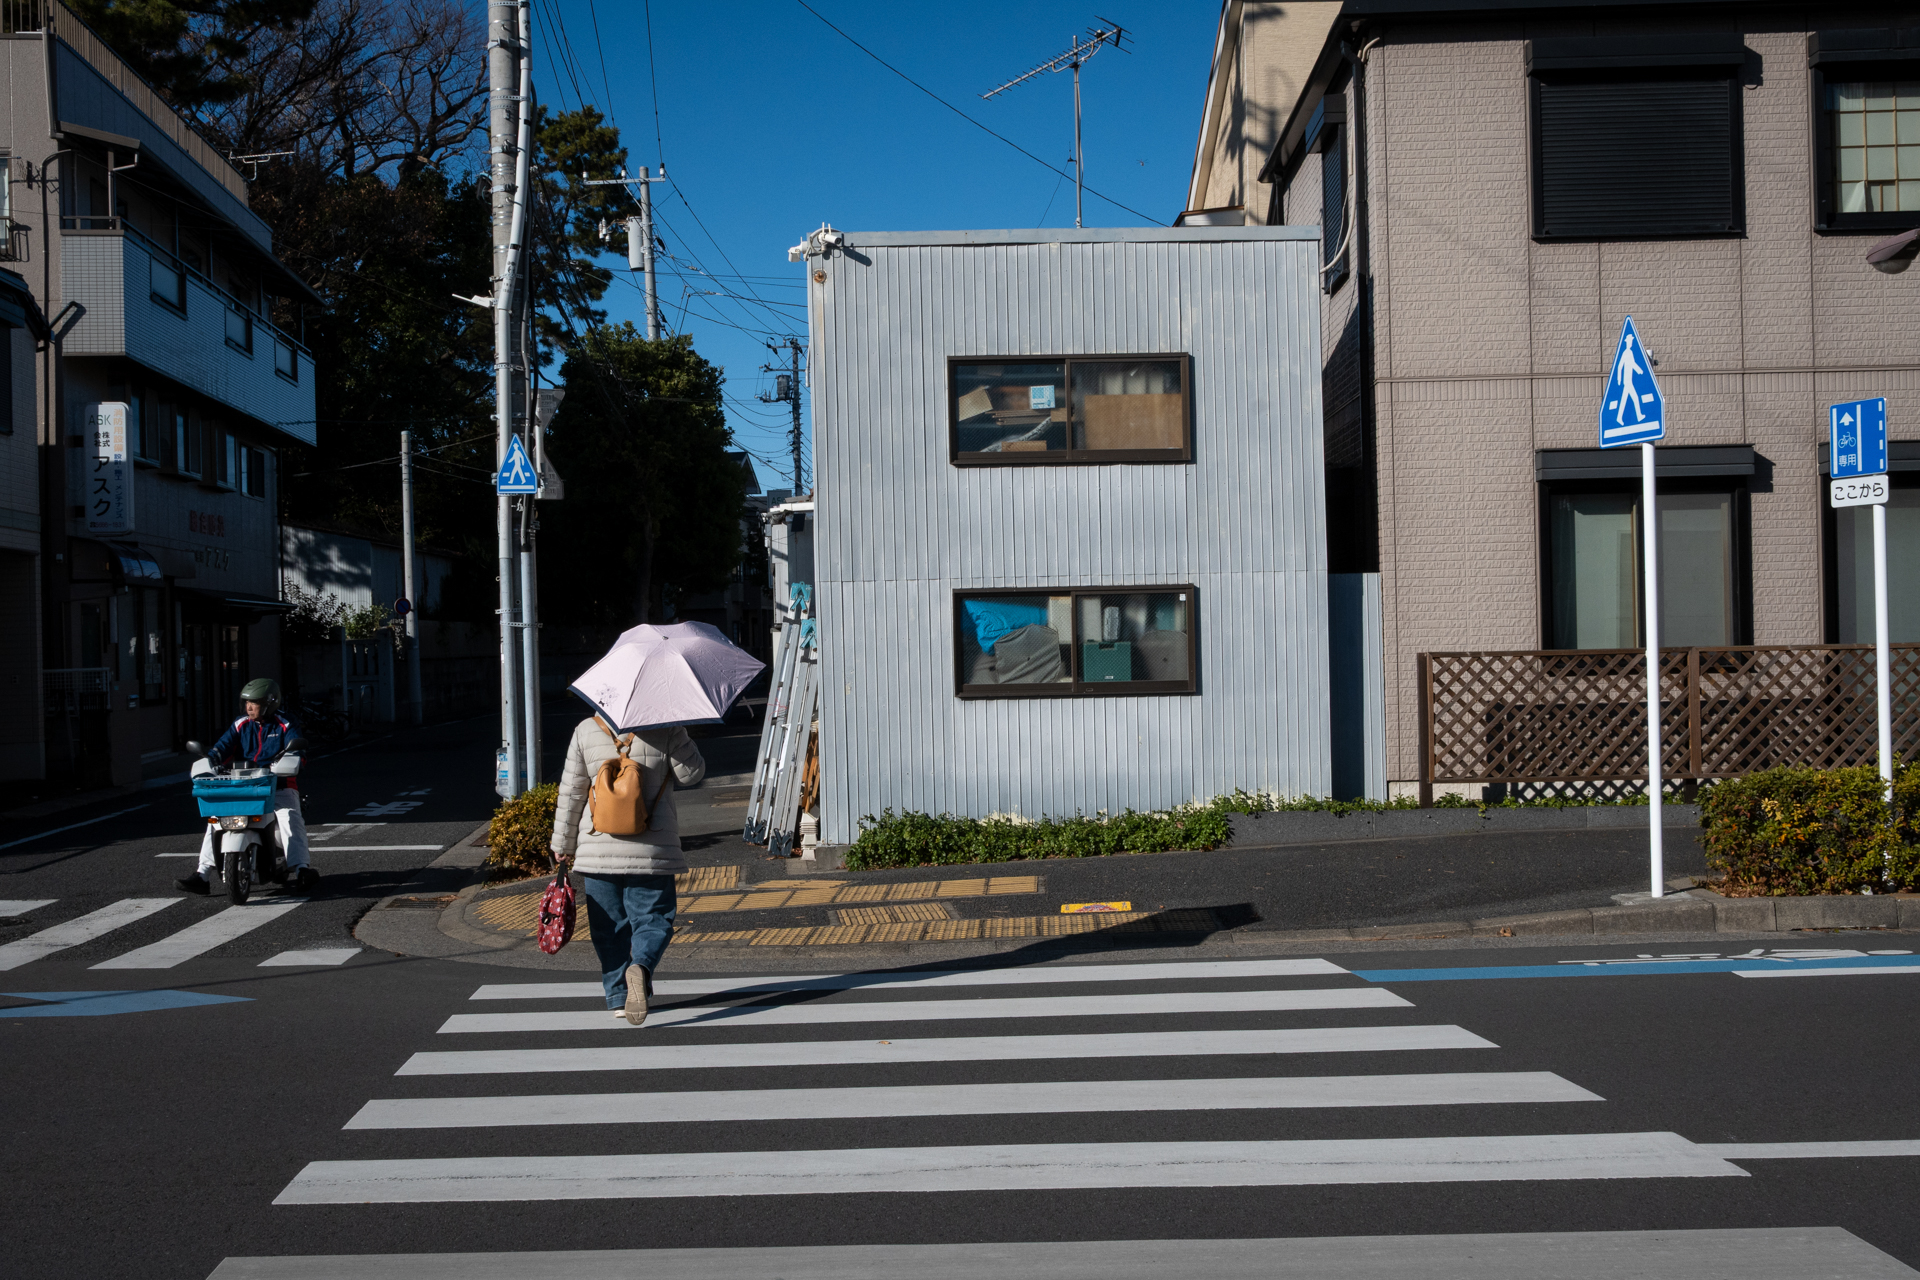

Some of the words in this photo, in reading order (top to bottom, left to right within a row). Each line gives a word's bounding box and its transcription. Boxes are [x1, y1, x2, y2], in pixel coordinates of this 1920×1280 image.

[88, 414, 112, 425] ASK
[113, 409, 124, 452] 消防用設備
[1838, 453, 1857, 467] 専用
[93, 456, 111, 517] アスク
[1834, 482, 1884, 501] ここから
[114, 485, 124, 519] メンテナンス
